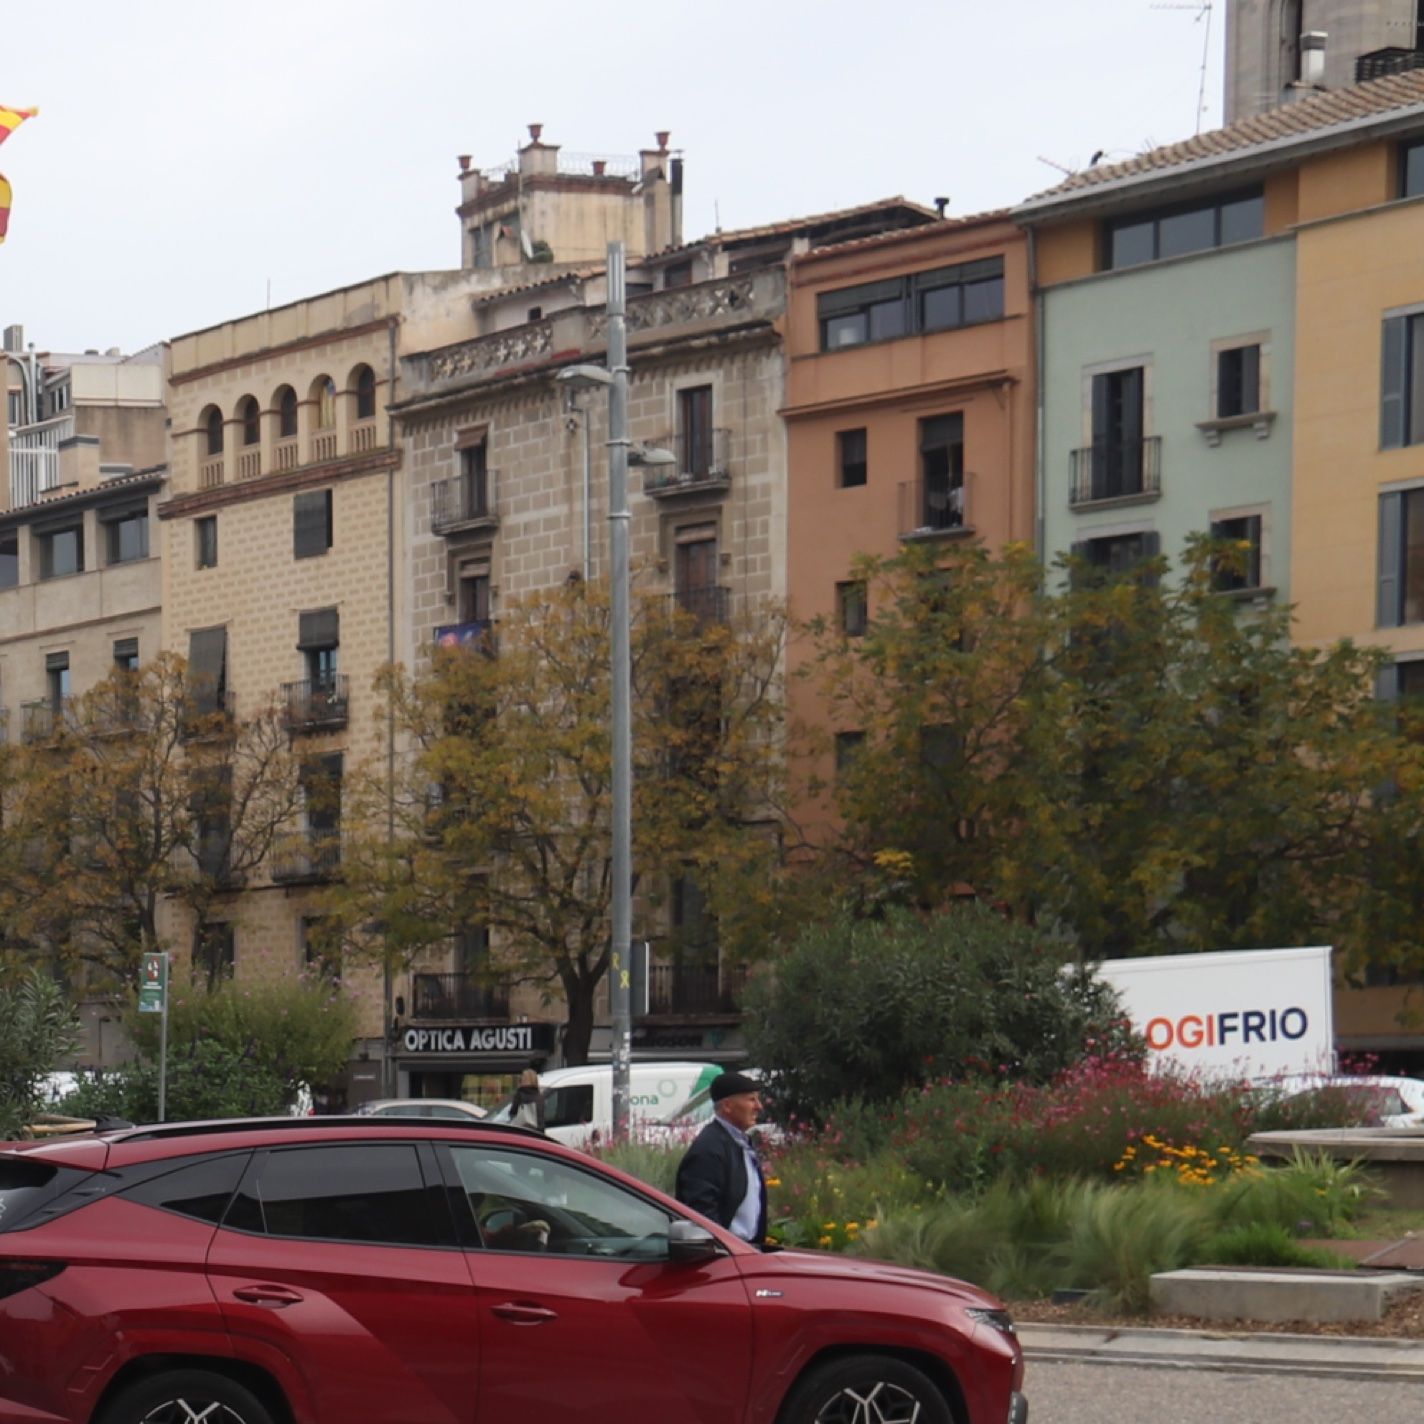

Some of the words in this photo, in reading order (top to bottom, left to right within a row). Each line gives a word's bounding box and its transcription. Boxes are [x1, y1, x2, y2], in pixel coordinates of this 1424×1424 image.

[404, 1028, 465, 1051] OPTICA
[470, 1027, 532, 1050] AGUSTI
[1145, 1007, 1308, 1051] OGIFRIO
